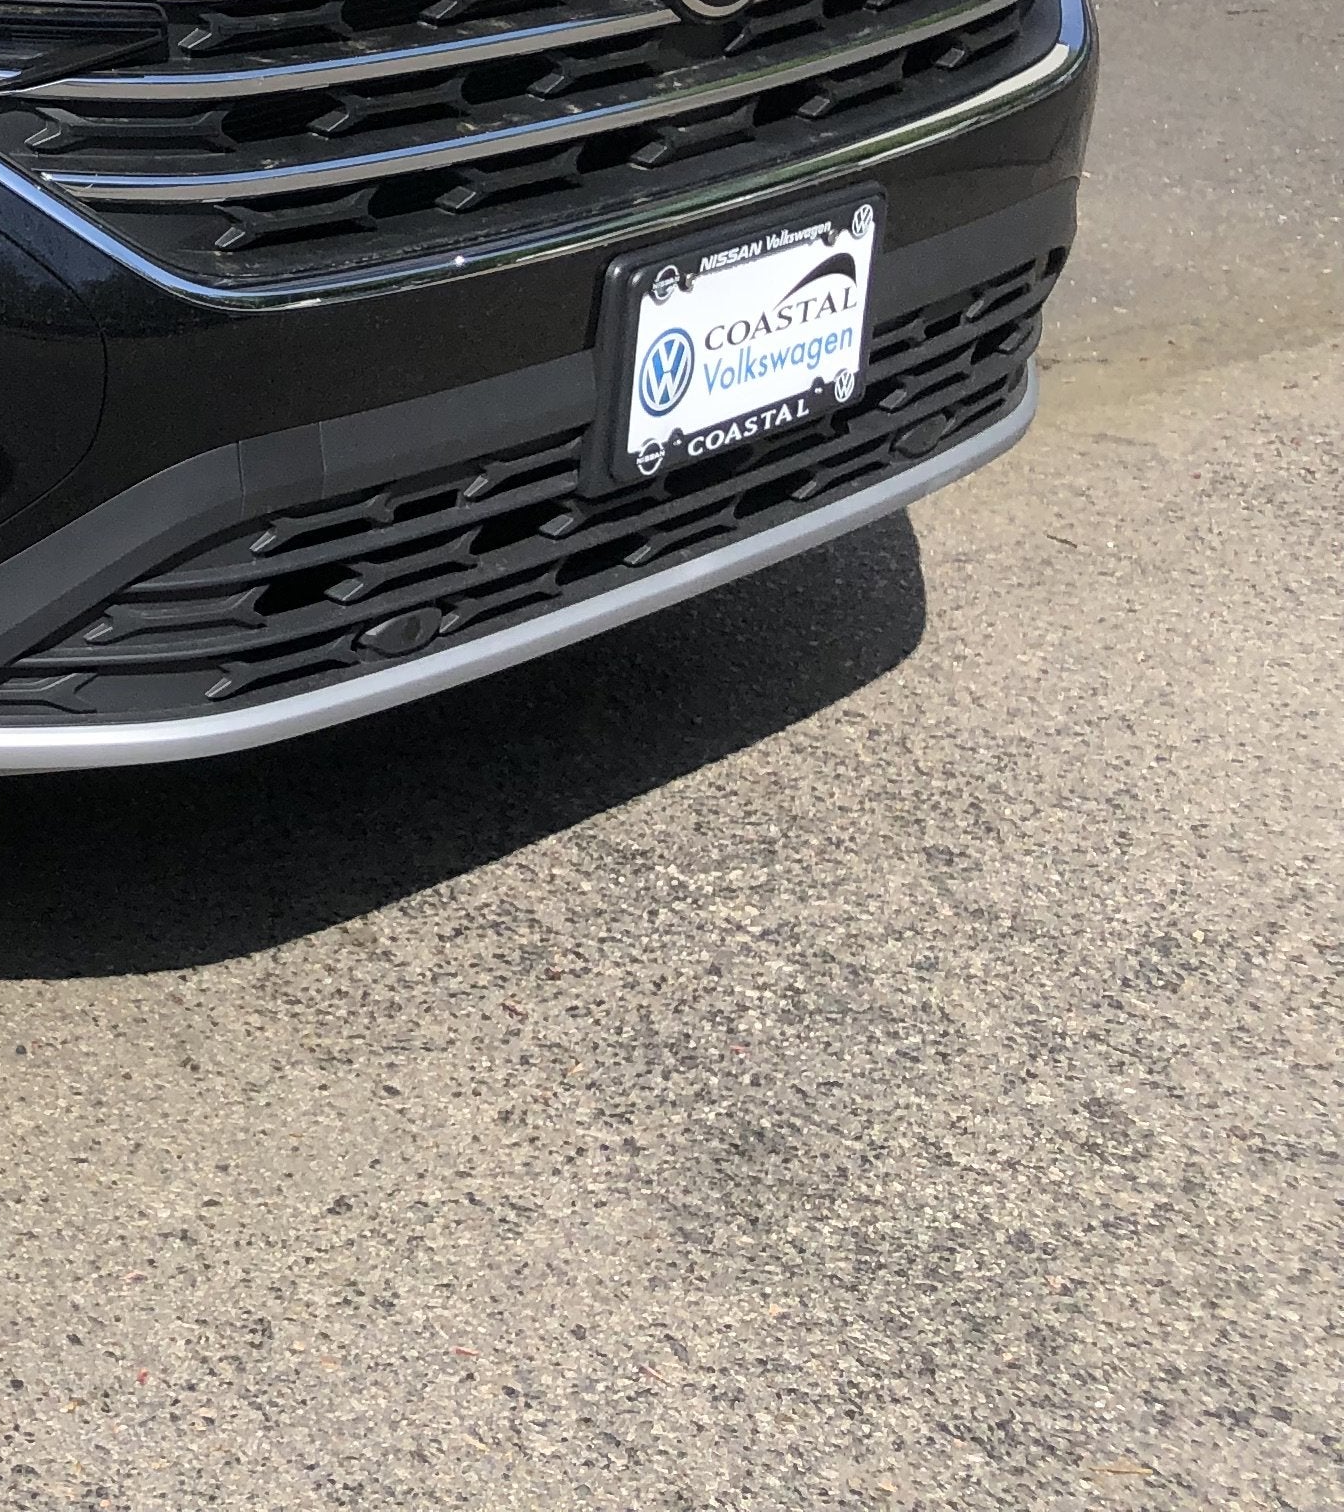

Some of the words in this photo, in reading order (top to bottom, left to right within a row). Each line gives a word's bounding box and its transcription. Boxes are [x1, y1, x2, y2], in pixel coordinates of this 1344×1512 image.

[700, 240, 763, 273] NISSAN
[765, 221, 832, 251] Volkswagen
[704, 286, 858, 351] COASTAL
[703, 327, 853, 394] Volkswagen
[688, 399, 810, 456] COASTAL
